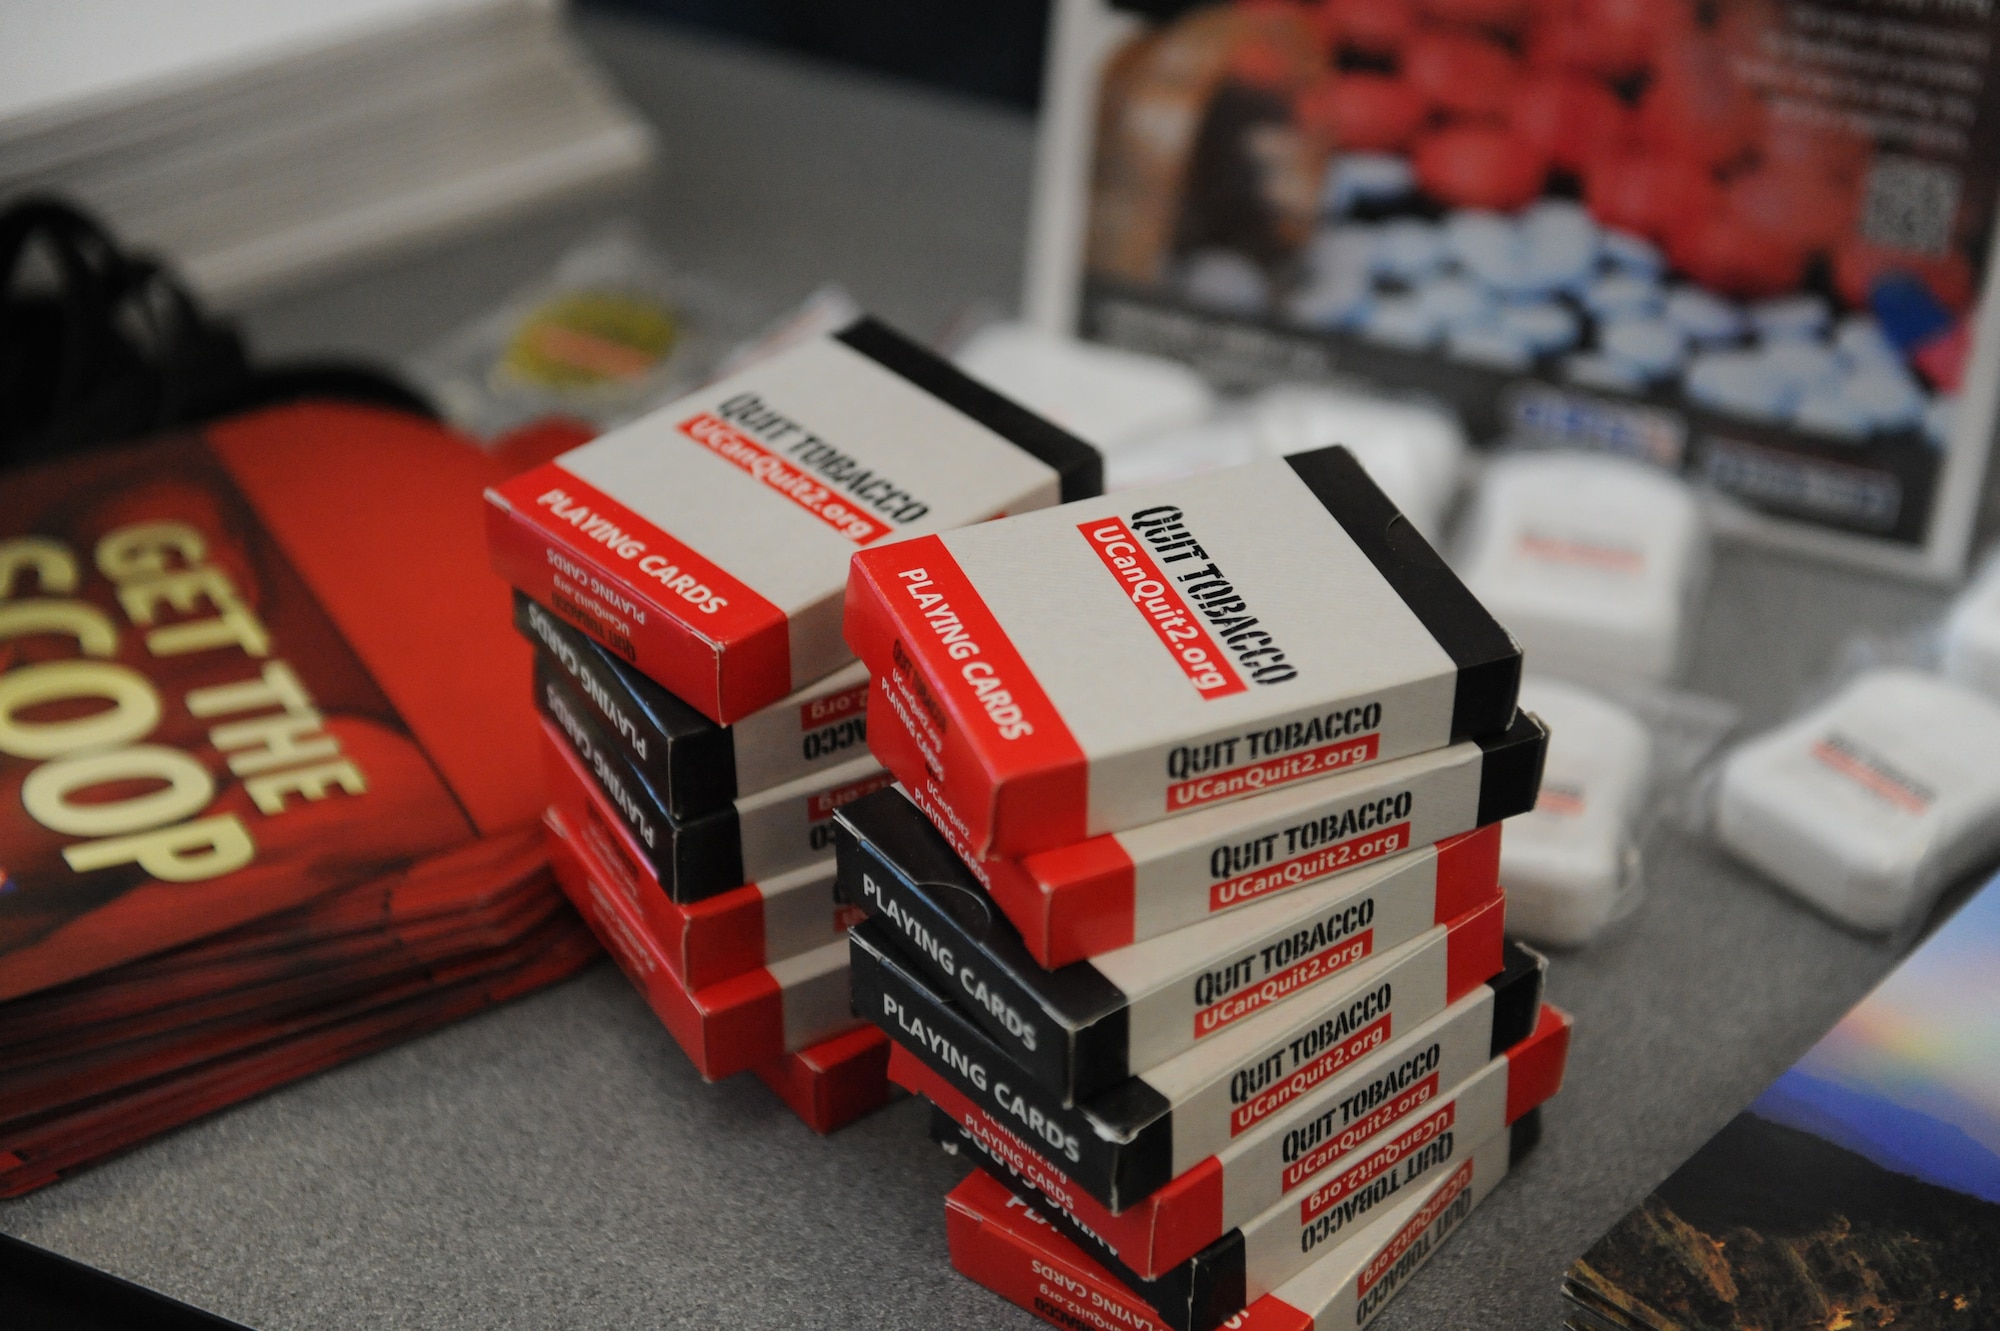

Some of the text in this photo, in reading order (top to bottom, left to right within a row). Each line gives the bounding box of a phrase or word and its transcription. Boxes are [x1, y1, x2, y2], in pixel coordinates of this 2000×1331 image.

[690, 417, 874, 541] UCanQuit2.org
[717, 391, 931, 525] QUIT TOBACCO
[536, 488, 729, 615] PLAYING CARDS
[546, 548, 647, 625] PLAYING CARDS
[1131, 505, 1299, 686] QUIT TOBACCO
[528, 602, 579, 677] CARDS
[898, 567, 1035, 741] PLAYING CARDS
[1093, 525, 1228, 691] UCanQuit2.org
[96, 520, 368, 817] GET THE
[580, 663, 648, 762] PLAYING
[1167, 701, 1383, 781] QUIT TOBACCO
[1175, 743, 1368, 806] UCanQuit2.org
[1210, 790, 1413, 880] QUIT TOBACCO
[1218, 831, 1401, 904] UCanQuit2.org
[862, 872, 1038, 1053] PLAYING CARDS
[1194, 898, 1375, 1007] QUIT TOBACCO
[1202, 939, 1365, 1030] UCanQuit2.org
[883, 992, 1081, 1164] PLAYING CARDS
[1230, 982, 1393, 1105] QUIT TOBACCO
[1238, 1024, 1384, 1128] UCanQuit2.org
[1282, 1042, 1441, 1164] QUIT TOBACCO
[1289, 1083, 1432, 1186] UCanQuit2.org
[965, 1113, 1075, 1211] PLAYING CARDS
[1301, 1131, 1455, 1255] QUIT TOBACCO
[1308, 1111, 1449, 1213] UCanQuit2.org
[1363, 1167, 1469, 1287] UCanQuit2.org
[1432, 1186, 1473, 1246] QUIT
[1031, 1259, 1088, 1299] CARDS
